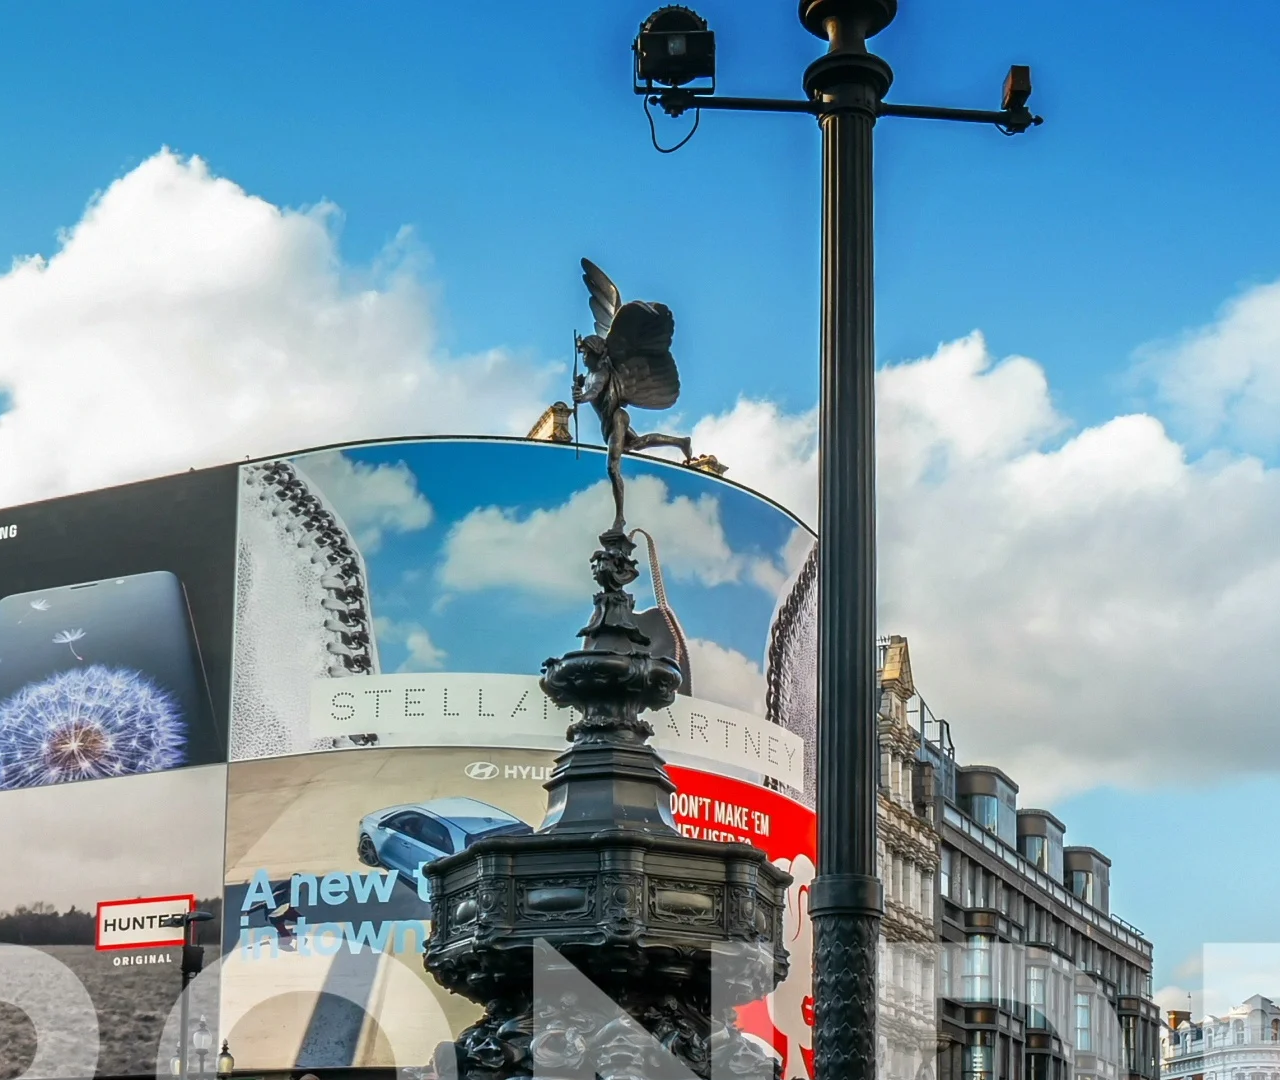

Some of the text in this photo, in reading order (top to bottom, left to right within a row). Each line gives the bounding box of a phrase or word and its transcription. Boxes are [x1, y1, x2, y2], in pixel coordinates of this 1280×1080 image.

[714, 800, 749, 831] MAKE
[241, 868, 277, 912] A
[290, 869, 399, 908] new
[238, 916, 426, 962] in town
[112, 953, 172, 967] ORIGINAL
